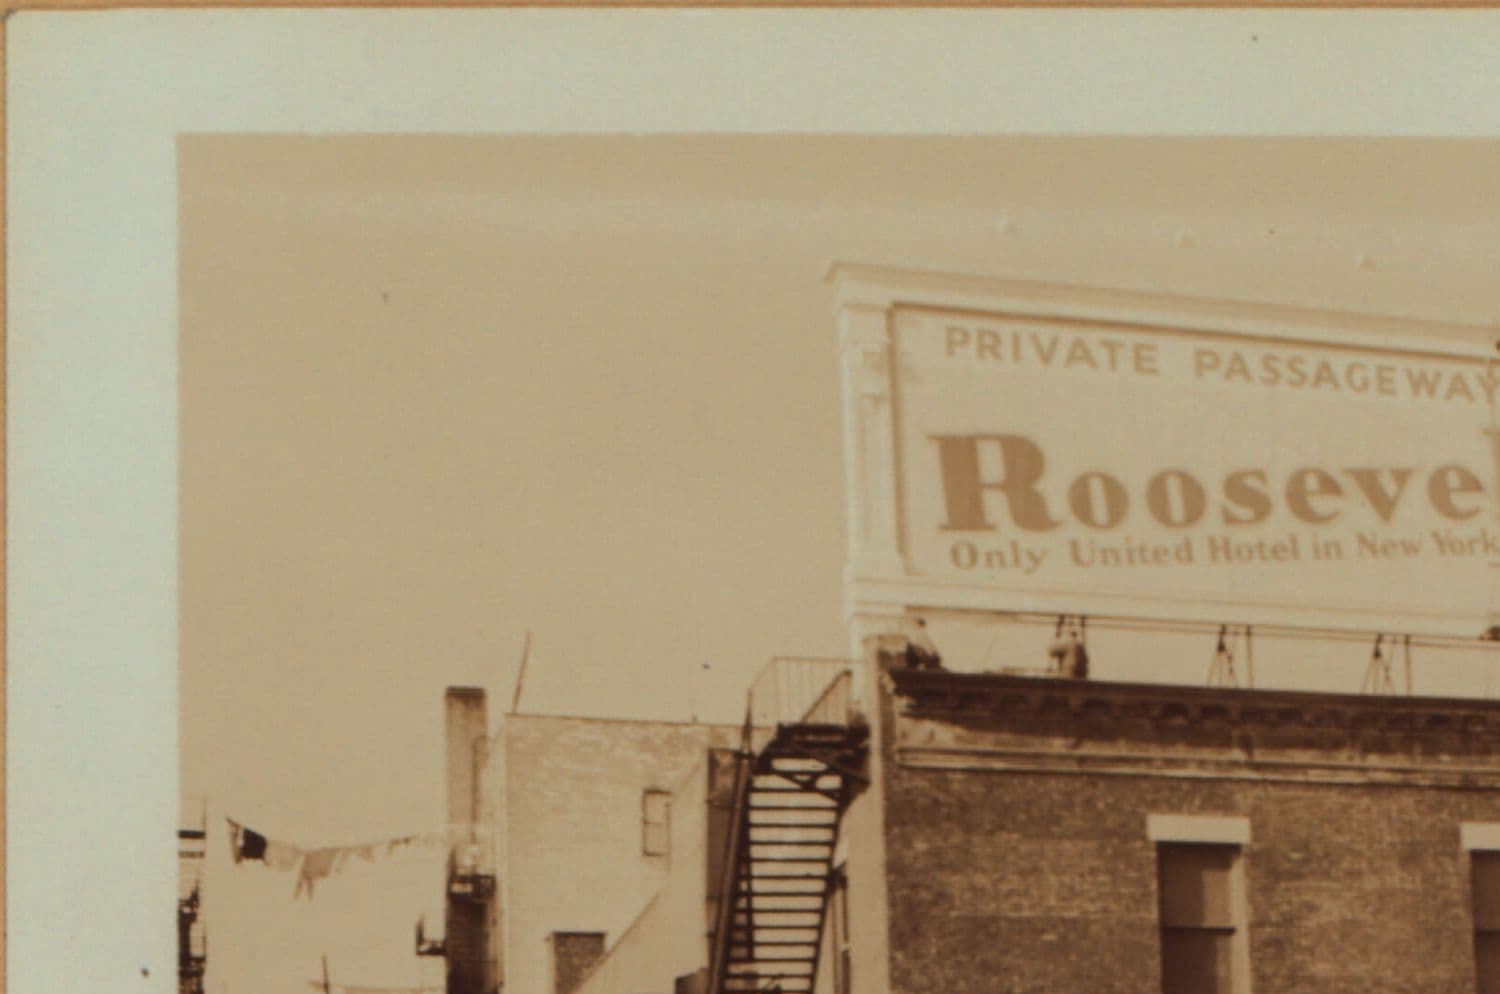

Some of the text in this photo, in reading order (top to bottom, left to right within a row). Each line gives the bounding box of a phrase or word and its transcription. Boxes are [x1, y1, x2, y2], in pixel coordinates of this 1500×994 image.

[945, 326, 1160, 375] PRIVATE
[1194, 349, 1500, 404] PASSAGEWAY
[950, 541, 1048, 575] Only
[1069, 535, 1193, 568] United
[1207, 535, 1301, 564] Hotel
[1312, 534, 1343, 559] in
[1356, 532, 1424, 559] New
[1427, 530, 1498, 556] York
